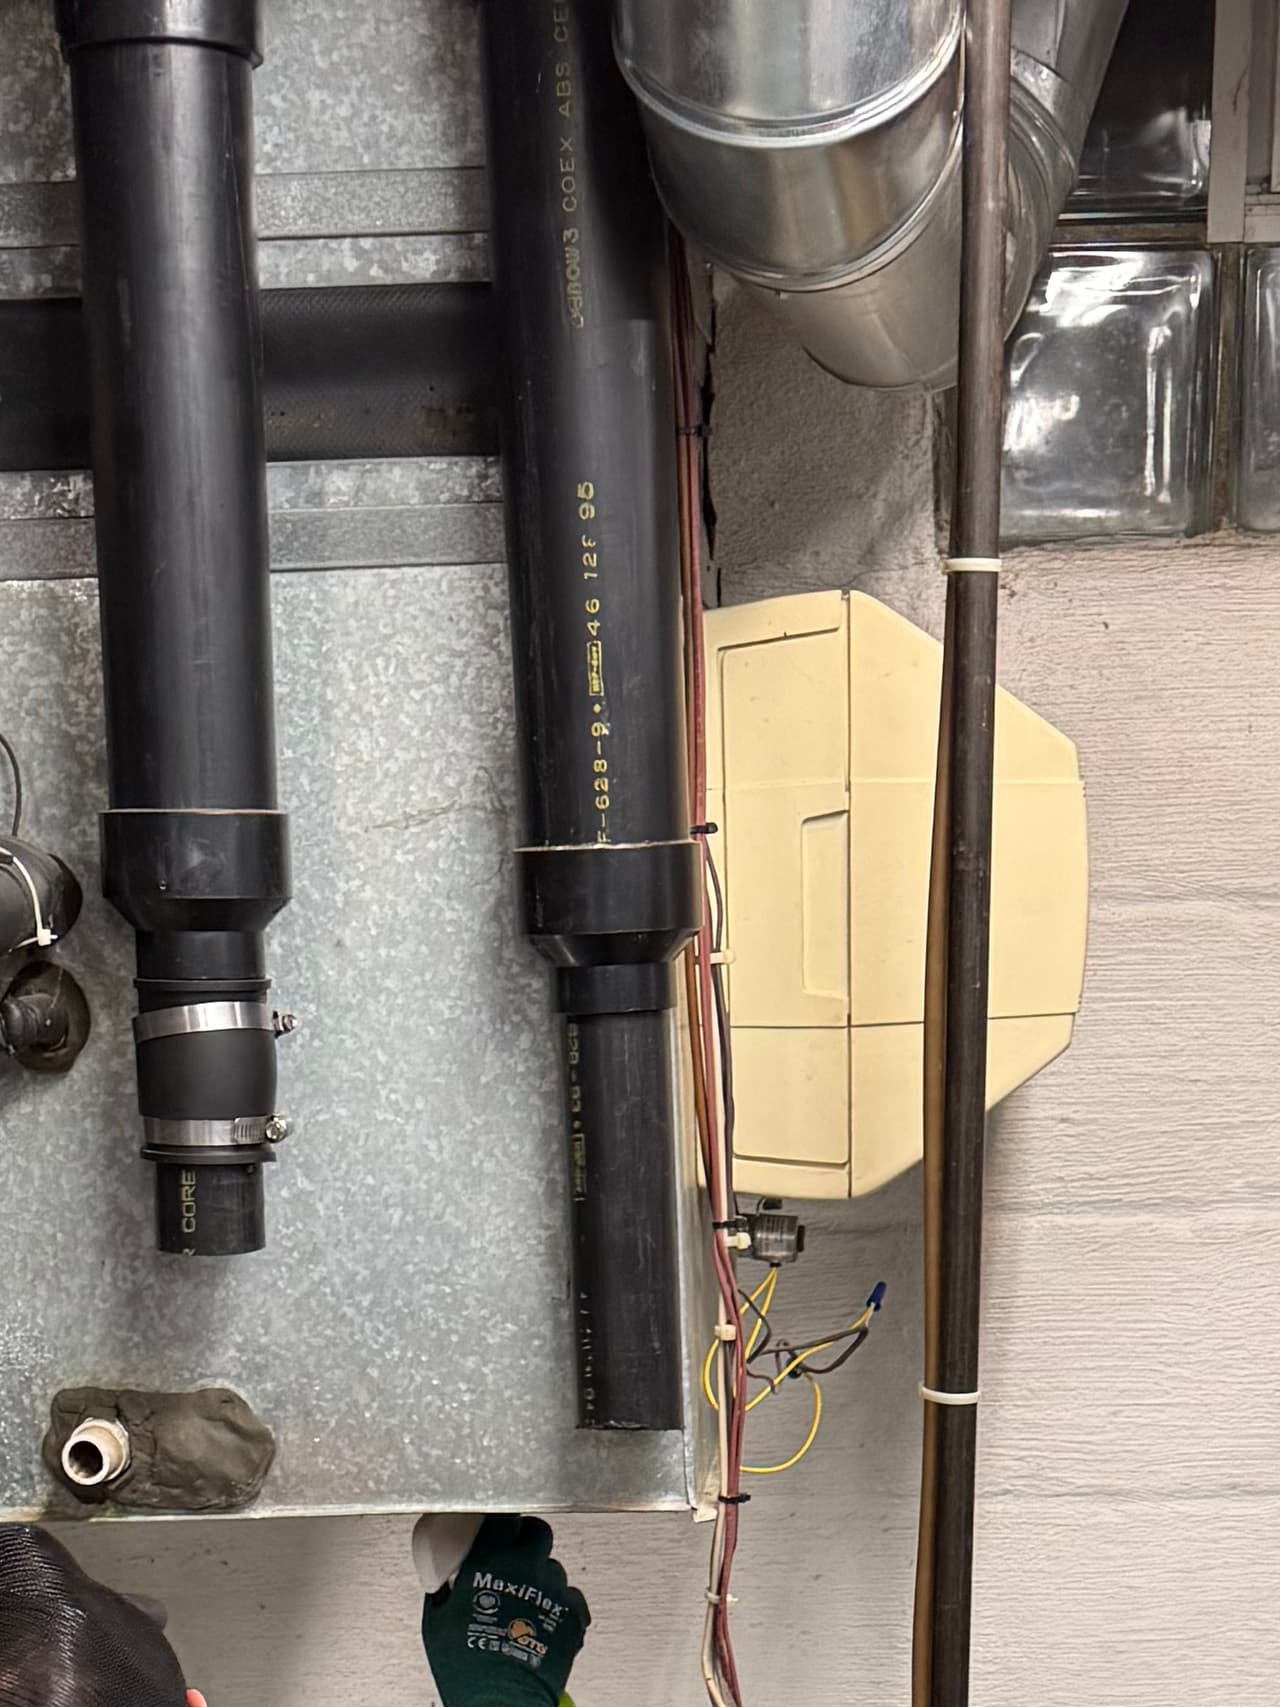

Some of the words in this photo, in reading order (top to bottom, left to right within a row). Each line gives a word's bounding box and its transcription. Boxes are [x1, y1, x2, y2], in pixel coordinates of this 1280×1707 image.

[555, 61, 571, 118] ABS
[181, 1169, 198, 1234] CORE
[472, 1571, 566, 1617] MaxiFlex
